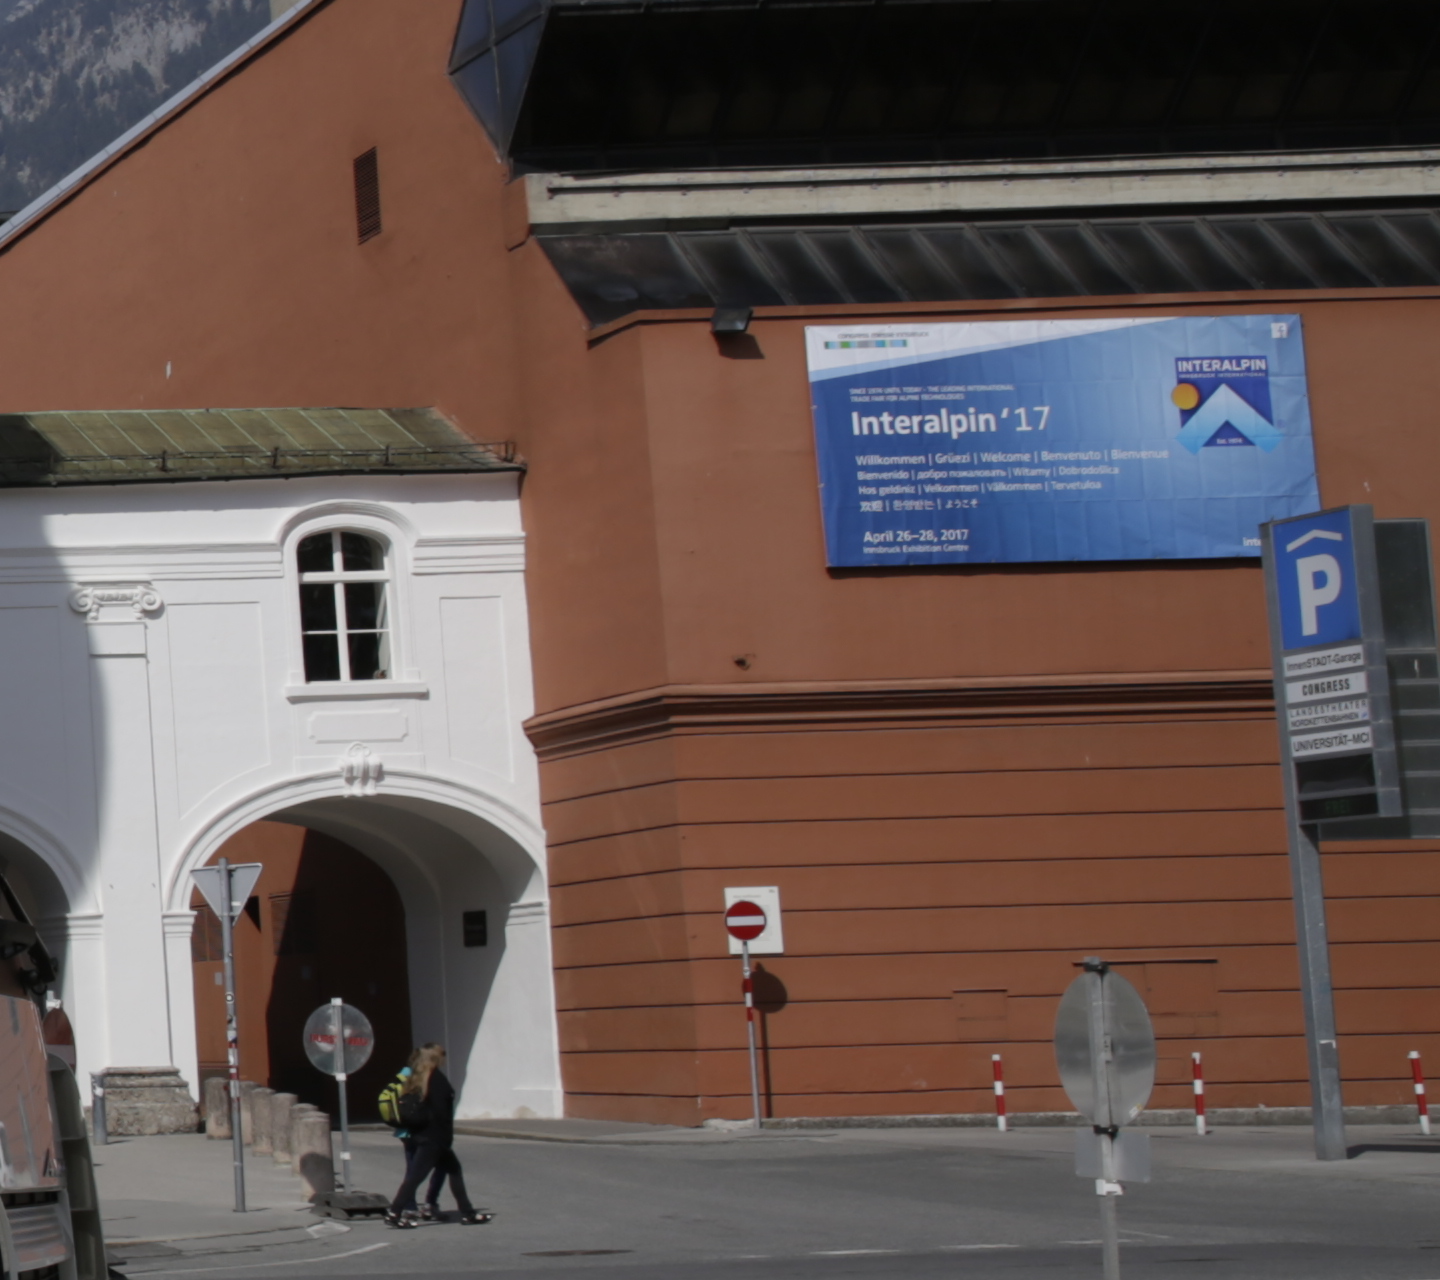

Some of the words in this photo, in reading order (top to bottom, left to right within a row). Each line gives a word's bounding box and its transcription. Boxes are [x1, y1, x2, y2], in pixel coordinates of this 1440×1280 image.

[1178, 359, 1266, 372] INTERALPIN
[851, 408, 996, 440] Interalpin
[856, 454, 926, 466] Willkommen
[935, 452, 970, 464] Grüezi
[980, 452, 1031, 462] Welcome
[1041, 450, 1101, 461] Benvenuto
[1111, 449, 1170, 460] Bienvenue
[857, 470, 909, 480] Bienvenido
[923, 484, 979, 494] Velkommen
[864, 530, 894, 544] April
[940, 528, 969, 541] 2017
[1296, 554, 1341, 636] P
[1287, 652, 1362, 671] InnenSTADT-Garage
[1302, 678, 1350, 696] CONGRESS
[1290, 700, 1368, 718] LANDESTHEATER
[1290, 712, 1358, 728] NORDKETTENBAHNEN
